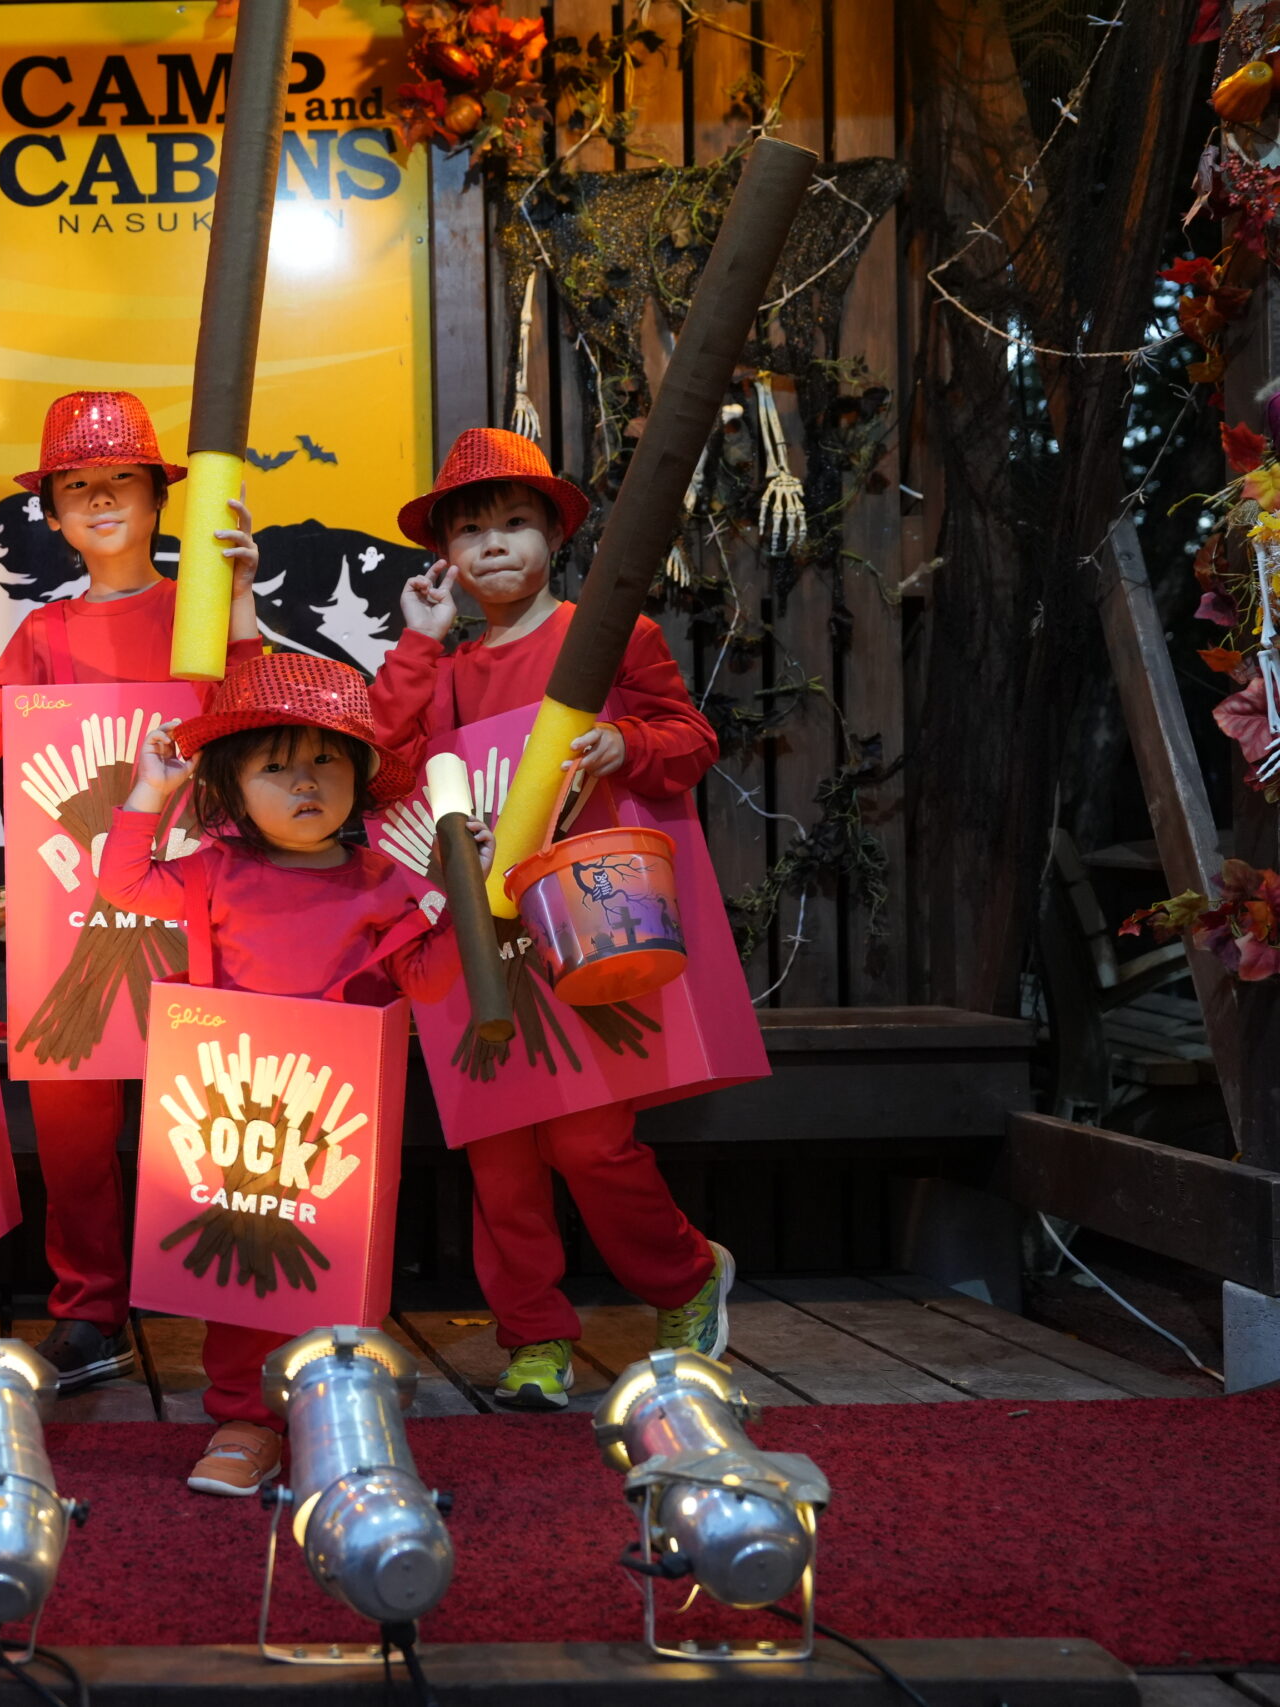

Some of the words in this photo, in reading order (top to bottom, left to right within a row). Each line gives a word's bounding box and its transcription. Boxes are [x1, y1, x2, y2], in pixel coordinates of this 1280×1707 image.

[1, 51, 326, 129] CAMP
[305, 87, 386, 121] and
[14, 693, 72, 717] Glico
[69, 911, 188, 928] CAMP
[167, 1003, 226, 1029] Glico
[190, 1184, 316, 1224] CAMPER
